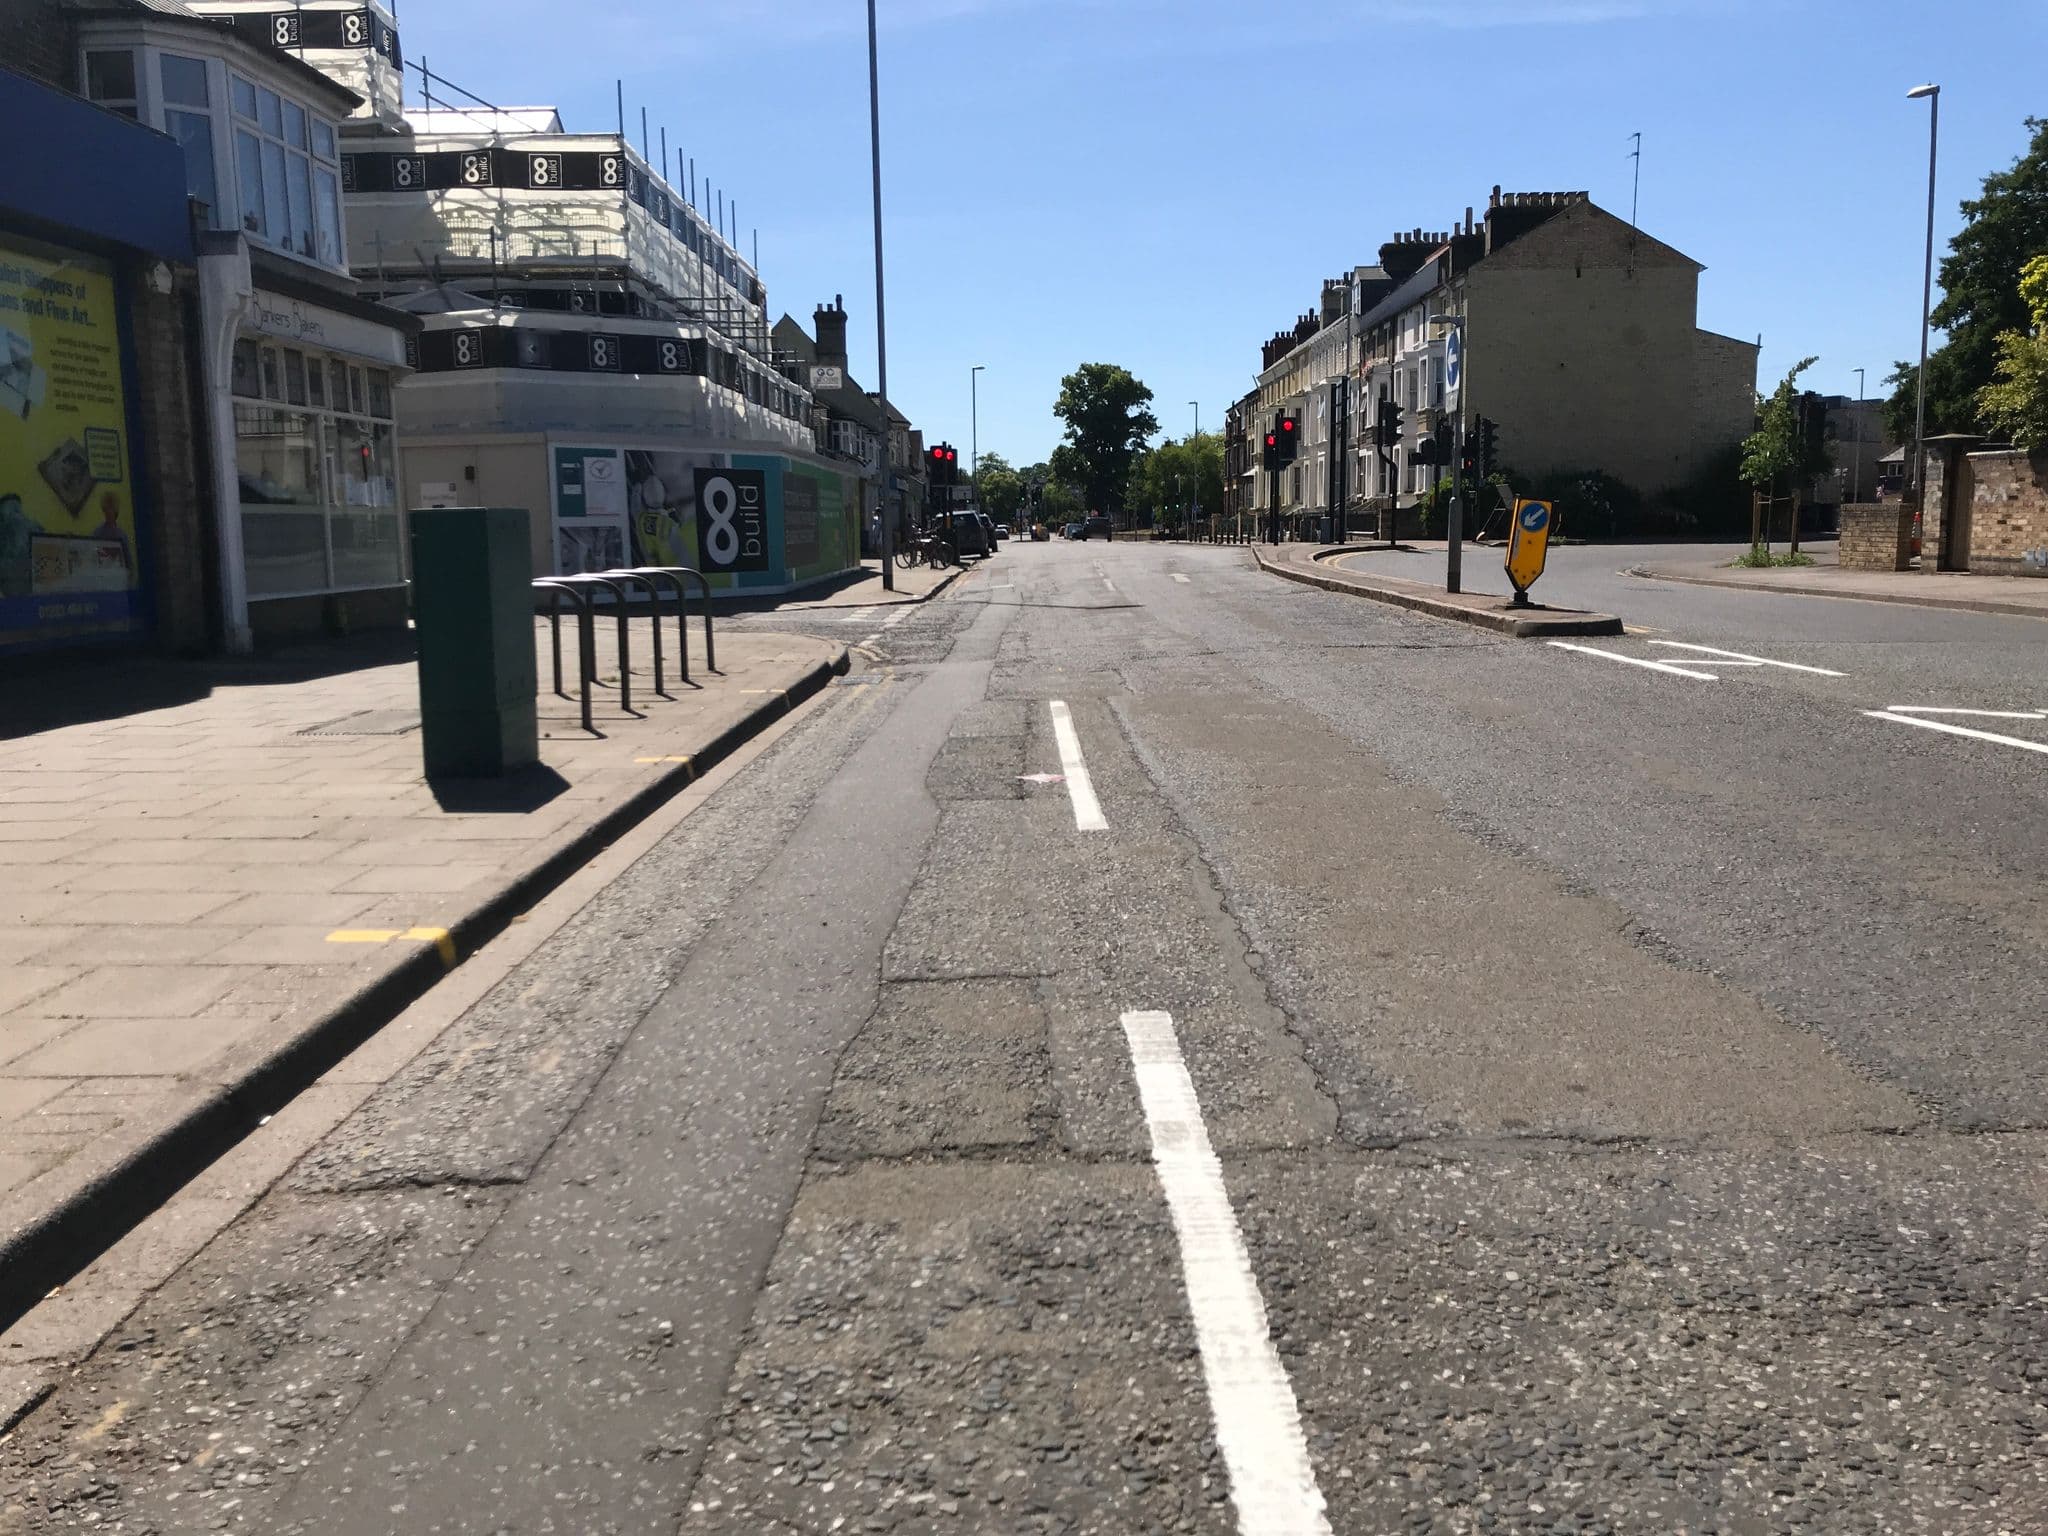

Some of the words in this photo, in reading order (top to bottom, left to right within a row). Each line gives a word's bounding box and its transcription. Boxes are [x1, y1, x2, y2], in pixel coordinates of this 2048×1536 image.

[276, 17, 289, 44] 8
[289, 18, 298, 41] build
[346, 15, 361, 43] 8
[361, 16, 369, 40] build
[397, 159, 411, 186] 8
[464, 155, 480, 183] 8
[479, 156, 488, 181] build
[534, 157, 548, 184] 8
[548, 159, 558, 183] build
[604, 158, 617, 184] 8
[457, 334, 471, 363] 8
[471, 336, 480, 361] build
[593, 338, 608, 367] 8
[608, 338, 617, 366] build
[662, 342, 678, 369] 8
[703, 476, 740, 565] 8
[738, 485, 762, 557] build
